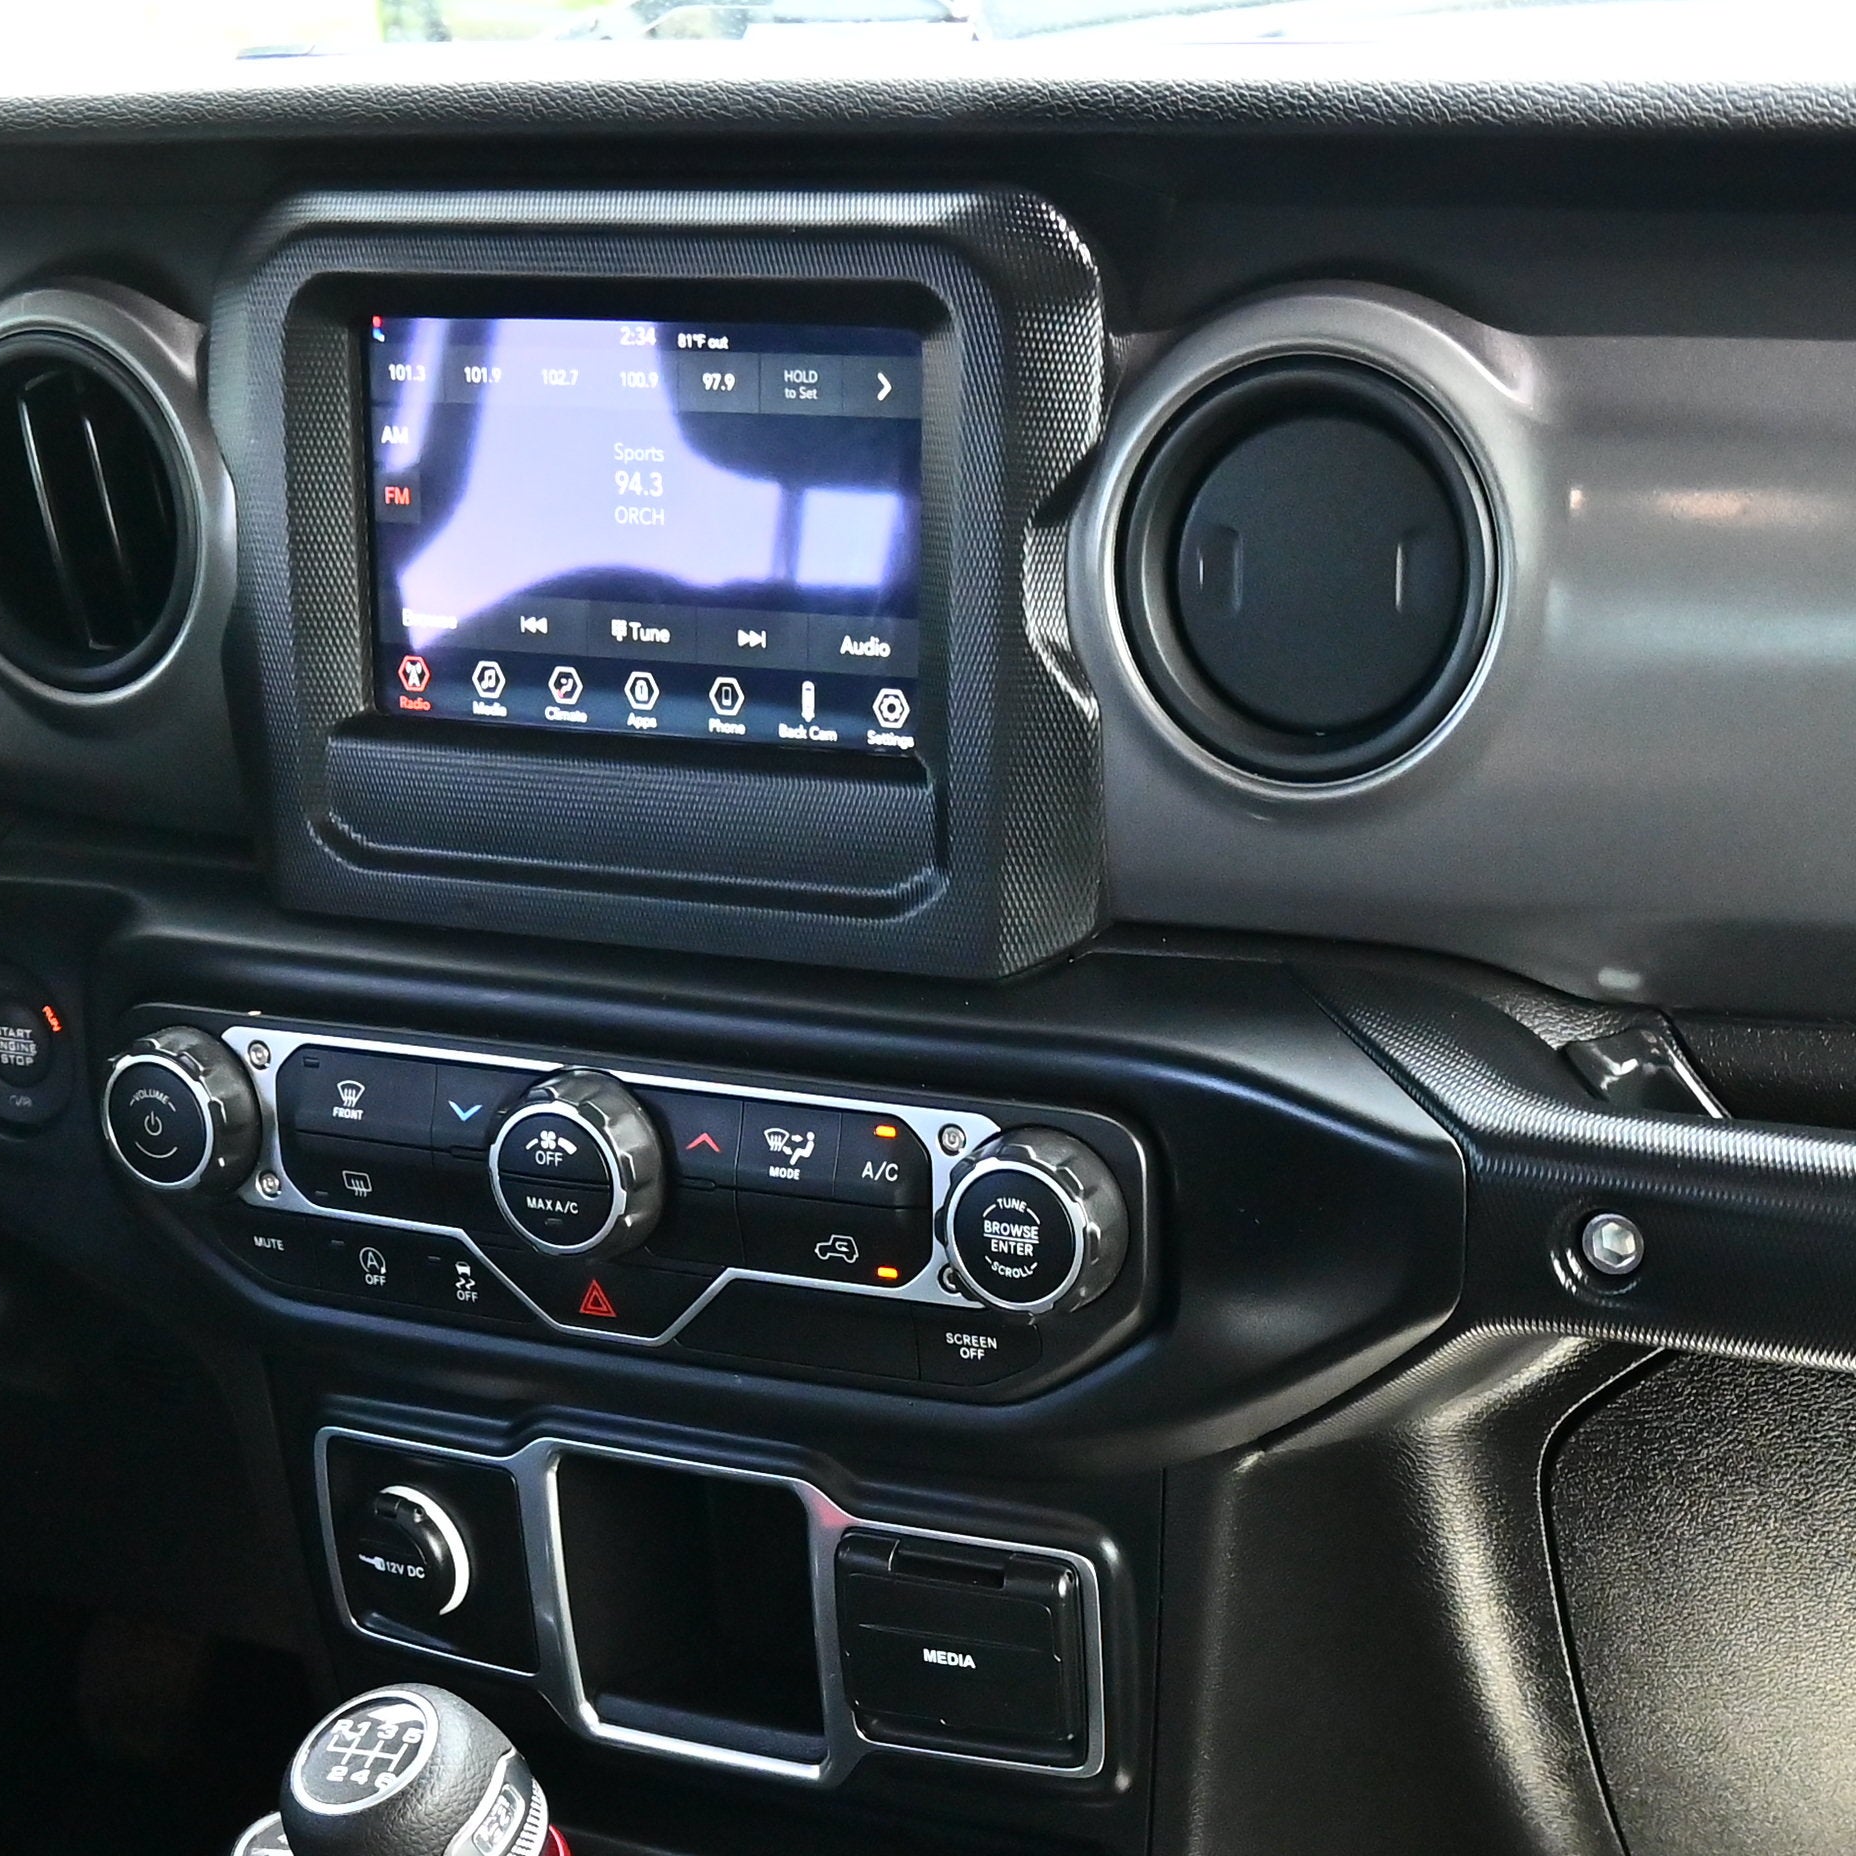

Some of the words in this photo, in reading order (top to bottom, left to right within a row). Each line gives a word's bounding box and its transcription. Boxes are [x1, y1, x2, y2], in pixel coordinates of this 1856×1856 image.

[620, 326, 656, 346] 2:34
[388, 364, 426, 381] 101.3
[464, 366, 501, 383] 101.9
[542, 368, 579, 386] 102.7
[619, 371, 659, 388] 100.9
[702, 372, 736, 391] 97.9
[784, 370, 817, 384] HOLD
[784, 386, 796, 399] to
[798, 386, 818, 400] Set
[380, 425, 409, 444] AM
[613, 442, 665, 464] Sports
[614, 470, 663, 498] 94.3
[384, 486, 410, 505] FM
[614, 506, 665, 526] ORCH
[629, 621, 671, 644] Tune
[840, 634, 892, 658] Audio
[399, 696, 432, 712] Radio
[472, 700, 508, 718] Media
[544, 706, 588, 723] Climate
[626, 712, 658, 729] Apps
[708, 717, 746, 736] Phone
[778, 722, 807, 740] Back
[866, 729, 915, 750] Settings
[0, 1053, 34, 1067] STOP
[133, 1089, 169, 1105] VOLUME
[332, 1106, 365, 1121] FRONT
[534, 1150, 564, 1167] OFF
[769, 1166, 801, 1181] MODE
[861, 1161, 899, 1182] A/C
[526, 1195, 555, 1212] MAX
[554, 1200, 579, 1216] A/C
[996, 1197, 1027, 1213] TUNE
[983, 1219, 1039, 1240] BROWSE
[253, 1235, 285, 1251] MUTE
[990, 1239, 1034, 1257] ENTER
[990, 1261, 1034, 1279] SCROLL
[364, 1273, 387, 1287] OFF
[456, 1289, 478, 1303] OFF
[945, 1332, 998, 1350] SCREEN
[959, 1346, 985, 1361] OFF
[386, 1561, 405, 1575] 12V
[406, 1565, 426, 1579] DC
[922, 1648, 977, 1670] MEDIA
[331, 1719, 353, 1737] R
[356, 1721, 372, 1737] 1
[377, 1723, 399, 1740] 3
[326, 1765, 348, 1782] 2
[350, 1769, 371, 1785] 4
